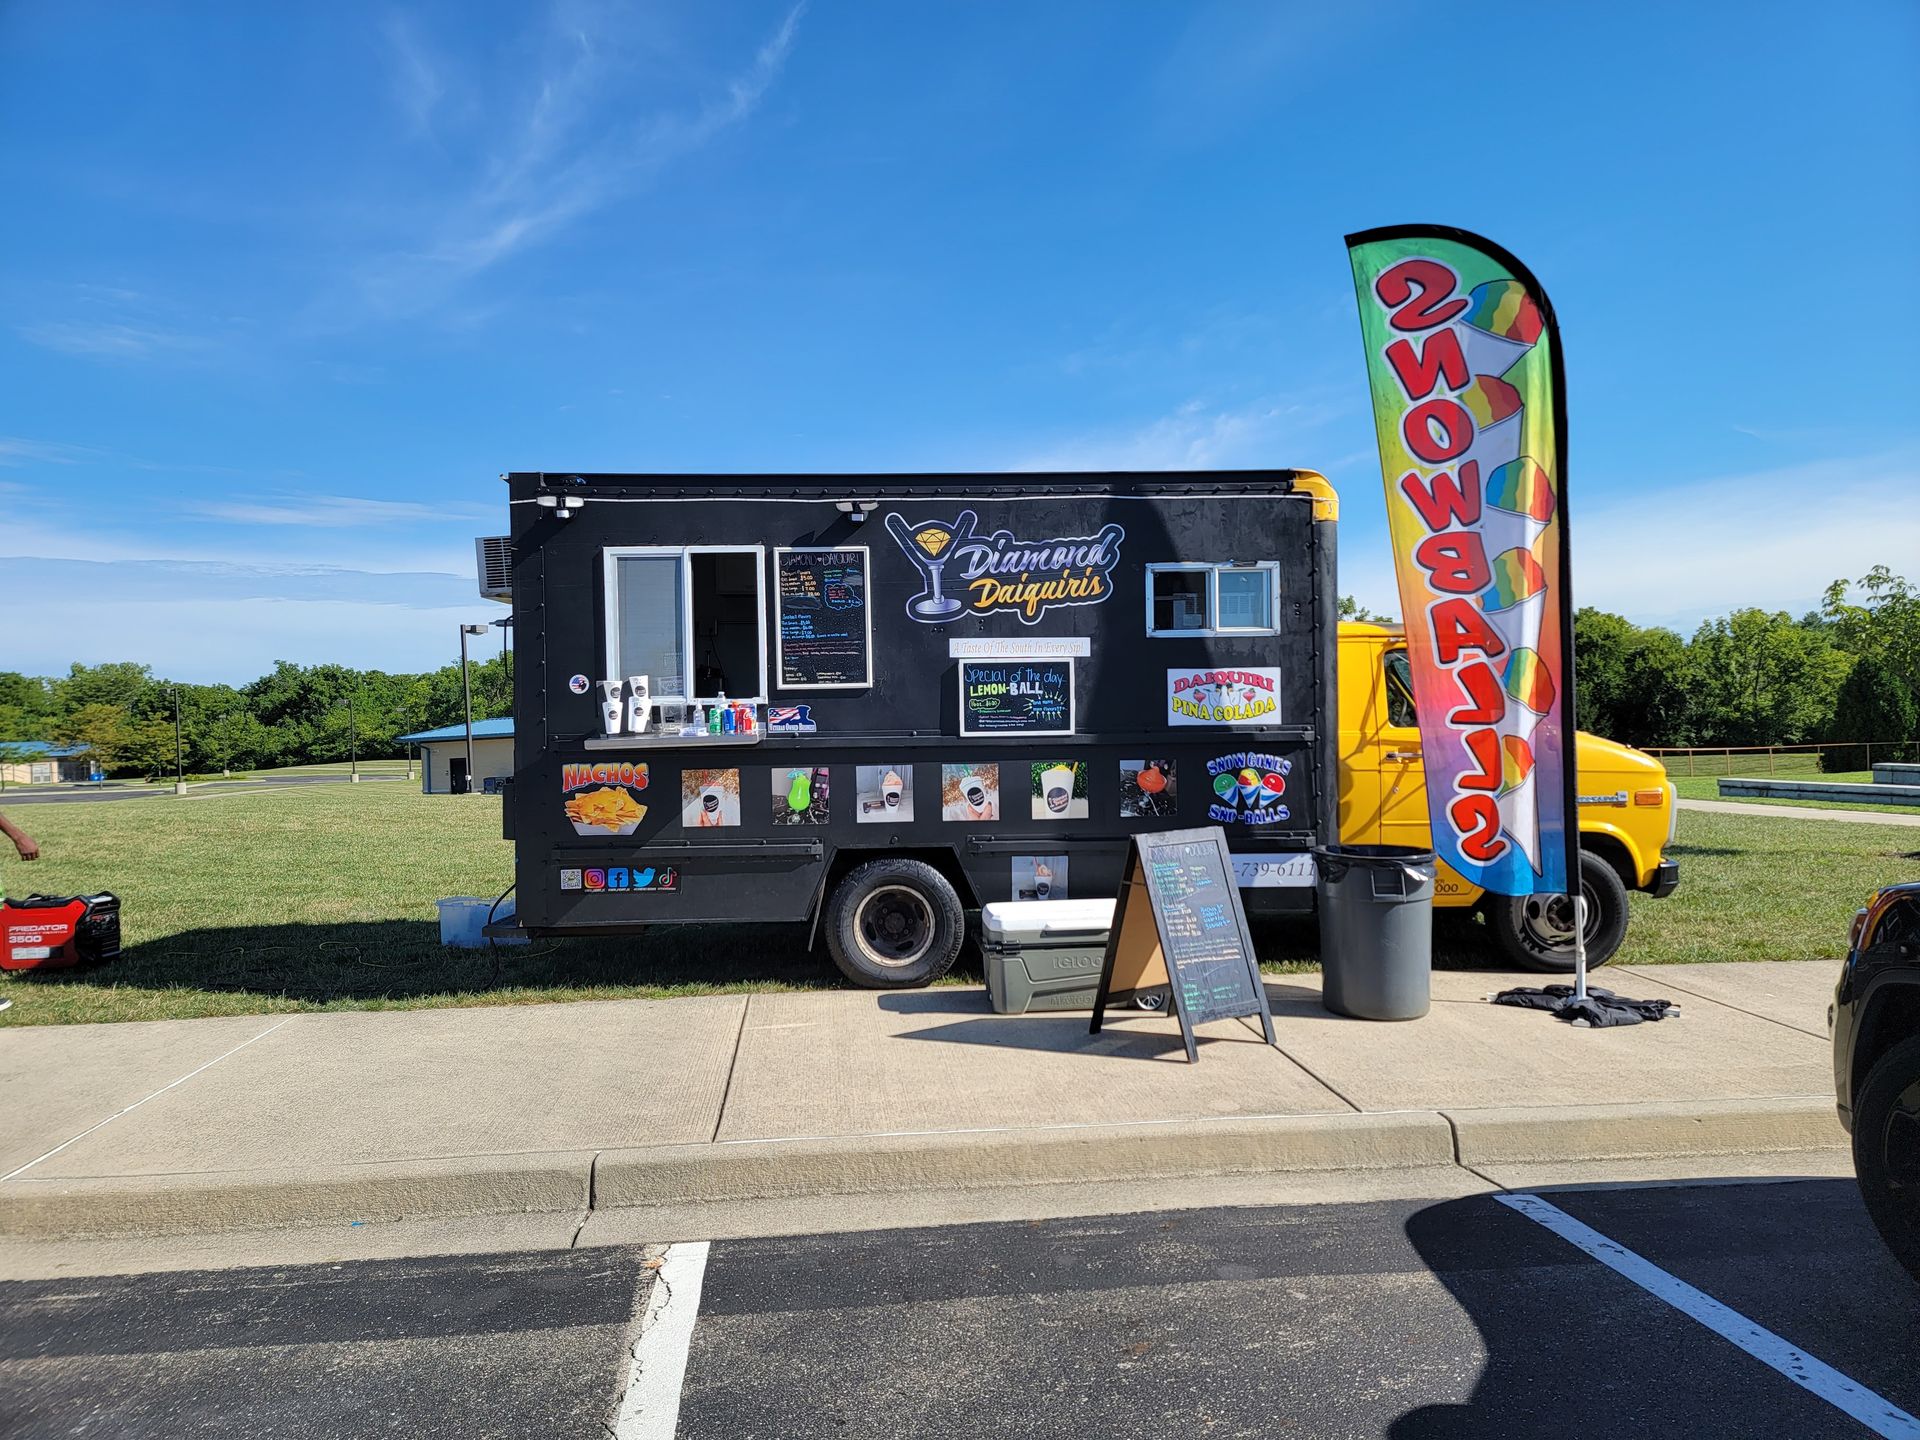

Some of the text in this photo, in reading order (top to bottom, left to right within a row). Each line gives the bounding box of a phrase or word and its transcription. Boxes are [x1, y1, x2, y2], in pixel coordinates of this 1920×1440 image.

[954, 533, 1117, 579] Diamond
[969, 567, 1105, 616] Daiquiris
[953, 642, 960, 654] A
[962, 641, 981, 654] Taste
[983, 641, 993, 655] Of
[996, 641, 1008, 654] The
[1010, 641, 1032, 654] South
[1045, 641, 1066, 655] Every
[965, 664, 1064, 688] Special of the day
[1174, 671, 1275, 694] DAIQUIRI
[1172, 696, 1276, 721] PINA COLADA
[1206, 752, 1293, 775] SNOW CONES
[562, 762, 649, 793] NACHOS
[1232, 862, 1315, 877] -739-6111
[8, 924, 68, 932] PREDATOR
[8, 935, 42, 943] 3500
